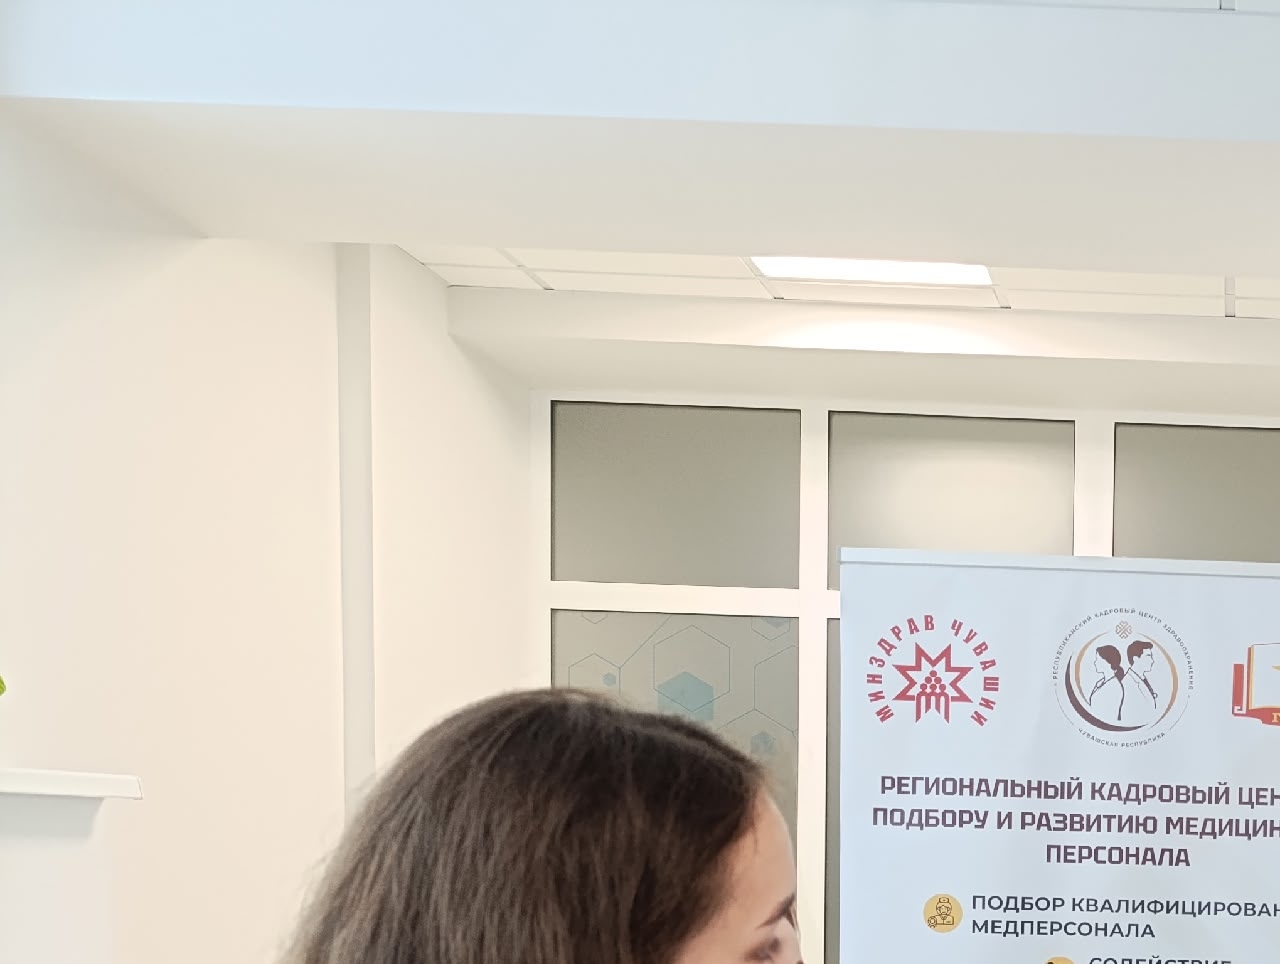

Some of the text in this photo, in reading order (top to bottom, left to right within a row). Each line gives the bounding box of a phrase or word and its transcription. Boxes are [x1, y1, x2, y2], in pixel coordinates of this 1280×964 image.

[1094, 607, 1136, 619] КАДРОВЫЙ
[1138, 611, 1162, 624] ЦЕНТР
[867, 615, 1000, 727] МИНЗДРАВ ЧУВАШИИ
[880, 775, 1083, 801] РЕГИОНАЛЬНЫЙ
[1090, 781, 1230, 806] КАДРОВЫЙ
[872, 807, 990, 831] ПОДБОРУ
[996, 810, 1013, 830] И
[1020, 811, 1158, 835] РАЗВИТИЮ
[1046, 844, 1191, 867] ПЕРСОНАЛА
[972, 895, 1066, 914] ПОДБОР
[972, 919, 1156, 938] МЕДПЕРСОНАЛА
